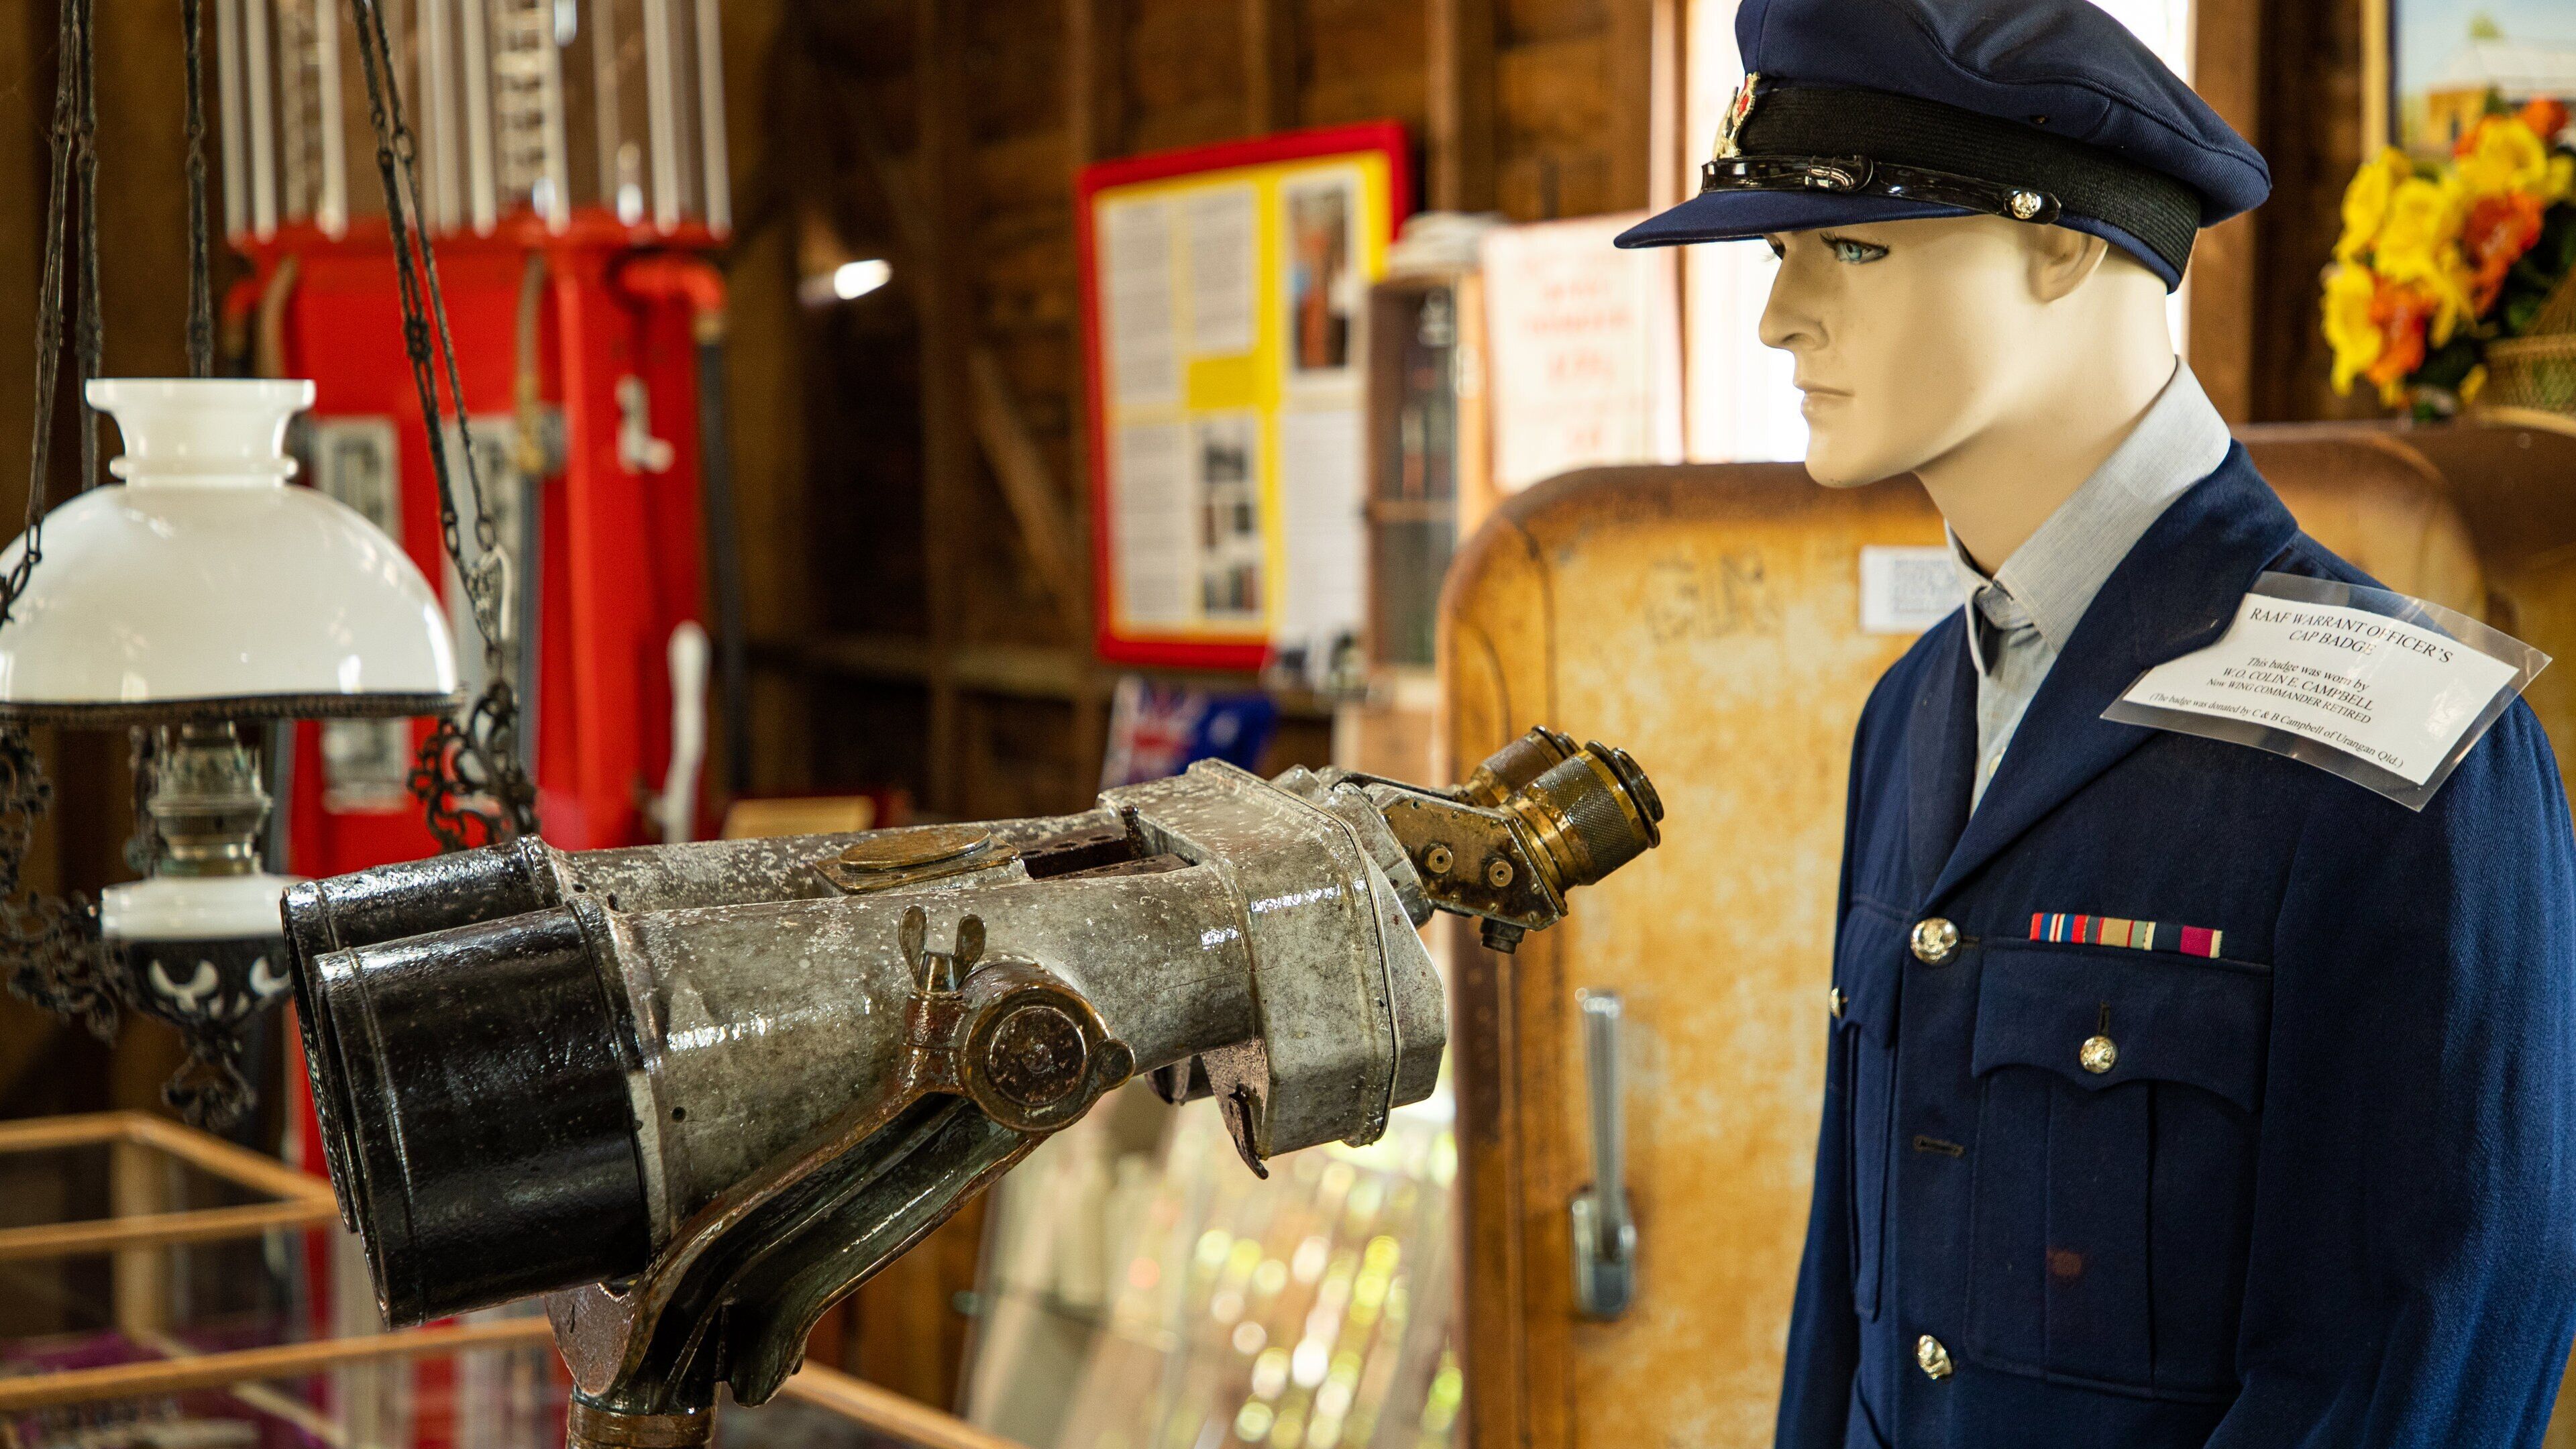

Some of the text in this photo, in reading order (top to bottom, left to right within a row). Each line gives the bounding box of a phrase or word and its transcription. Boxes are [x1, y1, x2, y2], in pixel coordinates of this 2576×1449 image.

[2250, 607, 2291, 623] RAAF
[2292, 613, 2367, 633] WARRANT
[2289, 629, 2376, 655] CAP BADGE
[2222, 667, 2374, 711] W.O. COLIN E. CAMPBELL
[2247, 657, 2370, 693] This badge was worn by
[2207, 678, 2372, 724] Now WING COMMANDER RETIRED
[2149, 692, 2169, 702] (The
[2168, 694, 2192, 706] badge
[2208, 702, 2241, 714] donated
[2239, 705, 2252, 716] by
[2252, 708, 2261, 716] C
[2260, 711, 2270, 719] &
[2270, 712, 2280, 721] B
[2280, 715, 2325, 735] Campbell
[2324, 731, 2339, 739] of
[2336, 732, 2376, 756] Urangan
[2377, 750, 2404, 769] Qld.)
